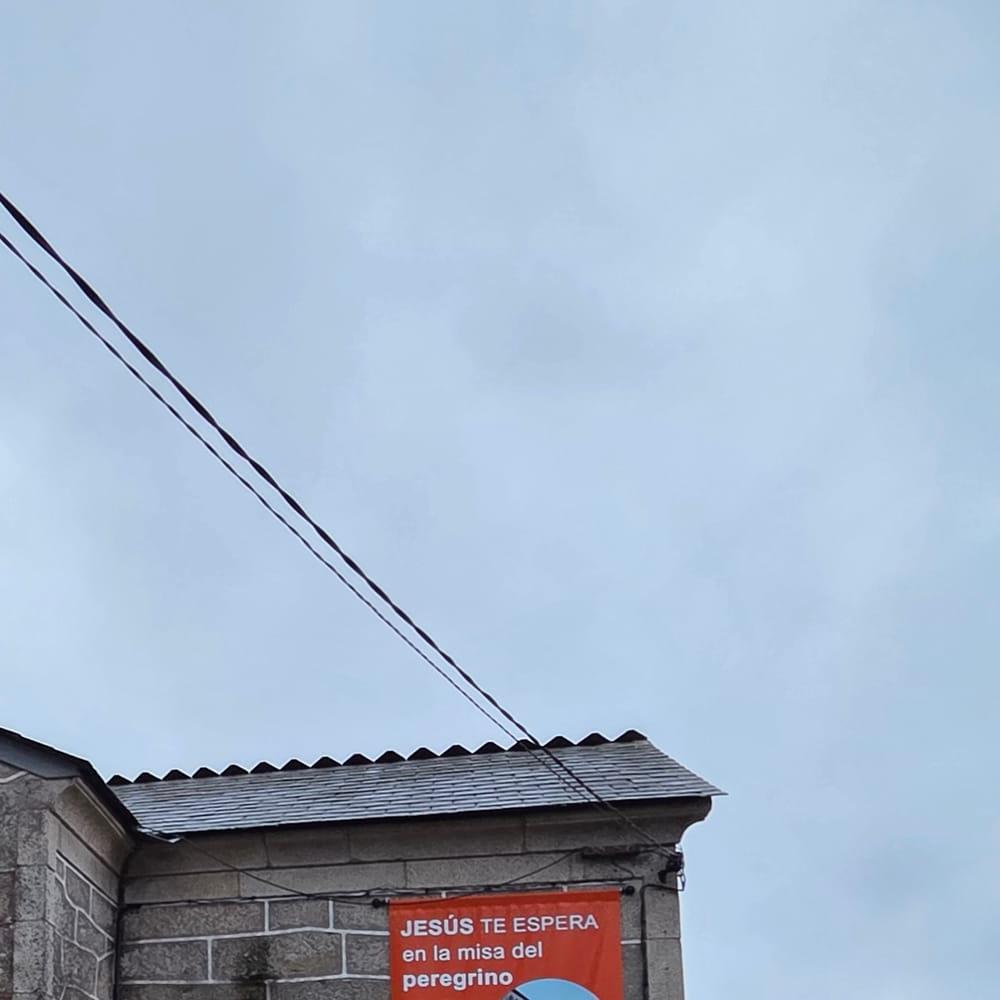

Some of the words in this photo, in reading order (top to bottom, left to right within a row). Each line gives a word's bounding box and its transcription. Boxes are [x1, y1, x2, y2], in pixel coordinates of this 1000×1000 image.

[400, 914, 474, 937] JESÚS
[480, 918, 506, 934] TE
[513, 914, 599, 933] ESPERA
[402, 949, 426, 962] en
[433, 945, 450, 961] la
[457, 943, 505, 960] misa
[512, 941, 543, 958] del
[402, 968, 513, 992] peregrino
